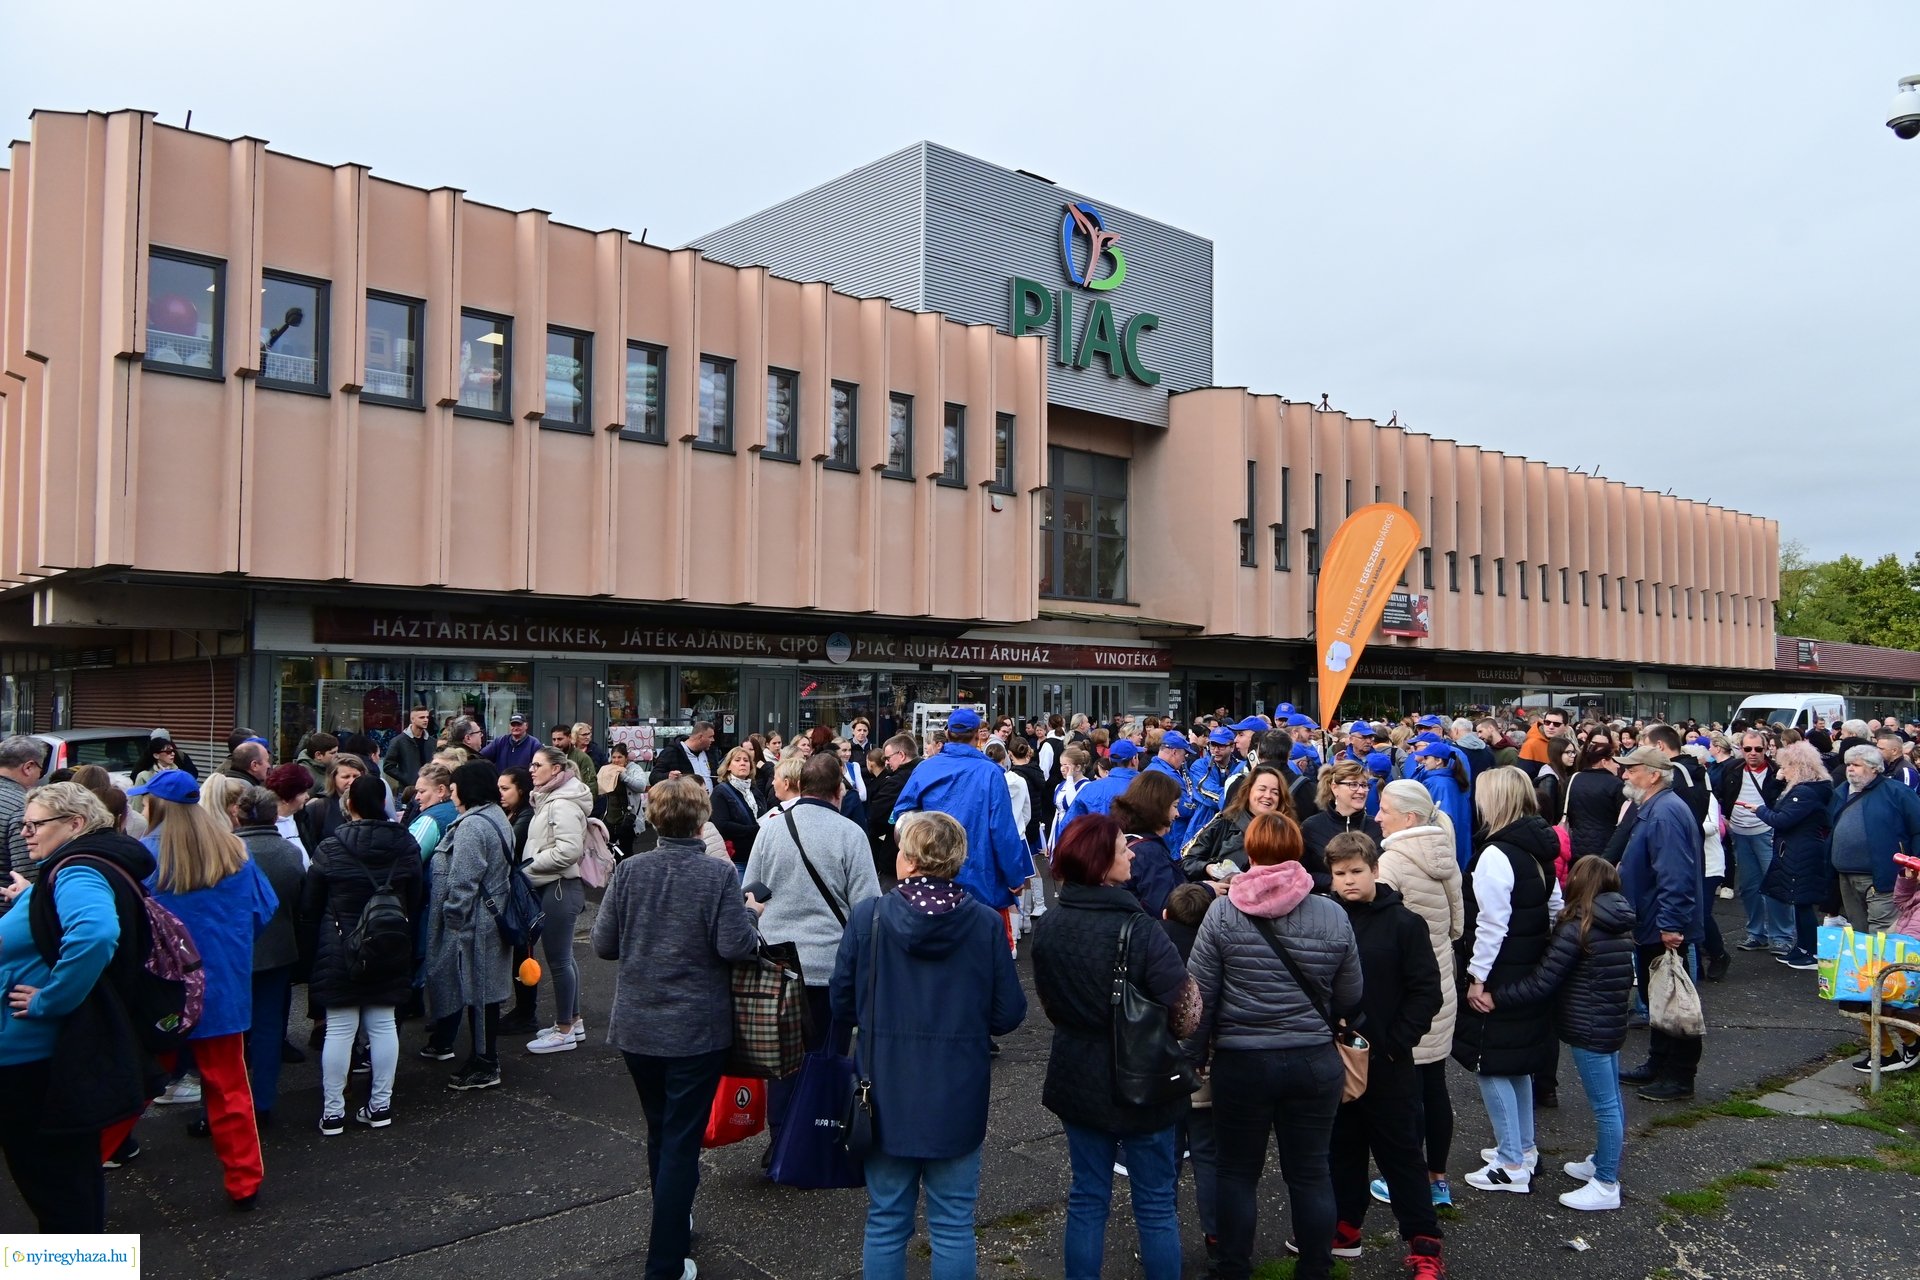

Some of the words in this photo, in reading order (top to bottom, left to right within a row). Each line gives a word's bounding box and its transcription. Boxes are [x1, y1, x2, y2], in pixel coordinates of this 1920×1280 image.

[1009, 275, 1161, 386] PIAC
[373, 616, 518, 642] HÁZTARTÁSI
[526, 626, 607, 649] CIKKEK,
[620, 627, 772, 654] JÁTÉK-AJÁNDÉK,
[856, 640, 897, 656] PIAC
[904, 639, 986, 661] RUHÁZATI
[990, 641, 1050, 663] ÁRUHÁZ
[1095, 650, 1158, 667] VINOTÉKA
